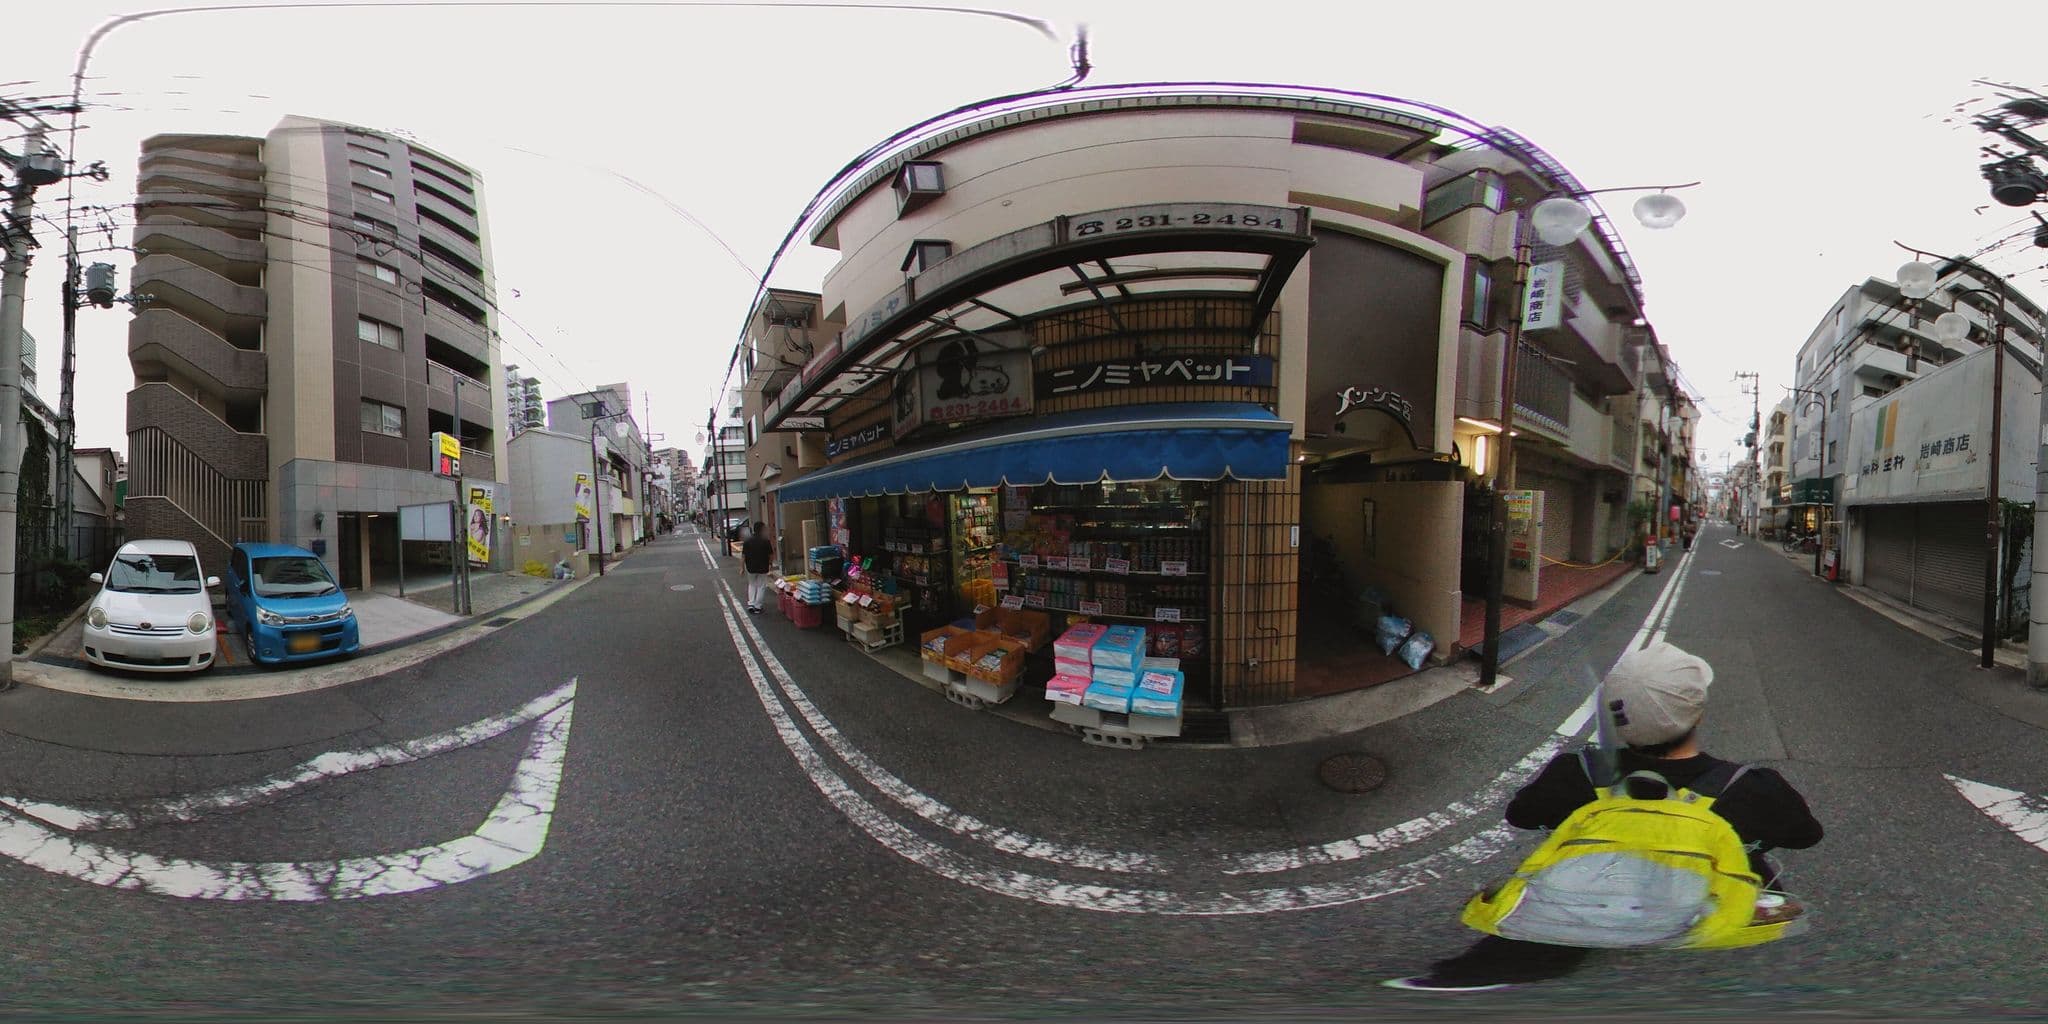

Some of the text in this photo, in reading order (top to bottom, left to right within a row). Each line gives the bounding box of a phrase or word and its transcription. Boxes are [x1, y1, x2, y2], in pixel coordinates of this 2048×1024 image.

[1116, 213, 1284, 230] 231-2484
[1053, 358, 1250, 392] ニノミヤペット
[829, 425, 885, 455] ニノミヤペット
[1920, 434, 1970, 460] 岩崎商店
